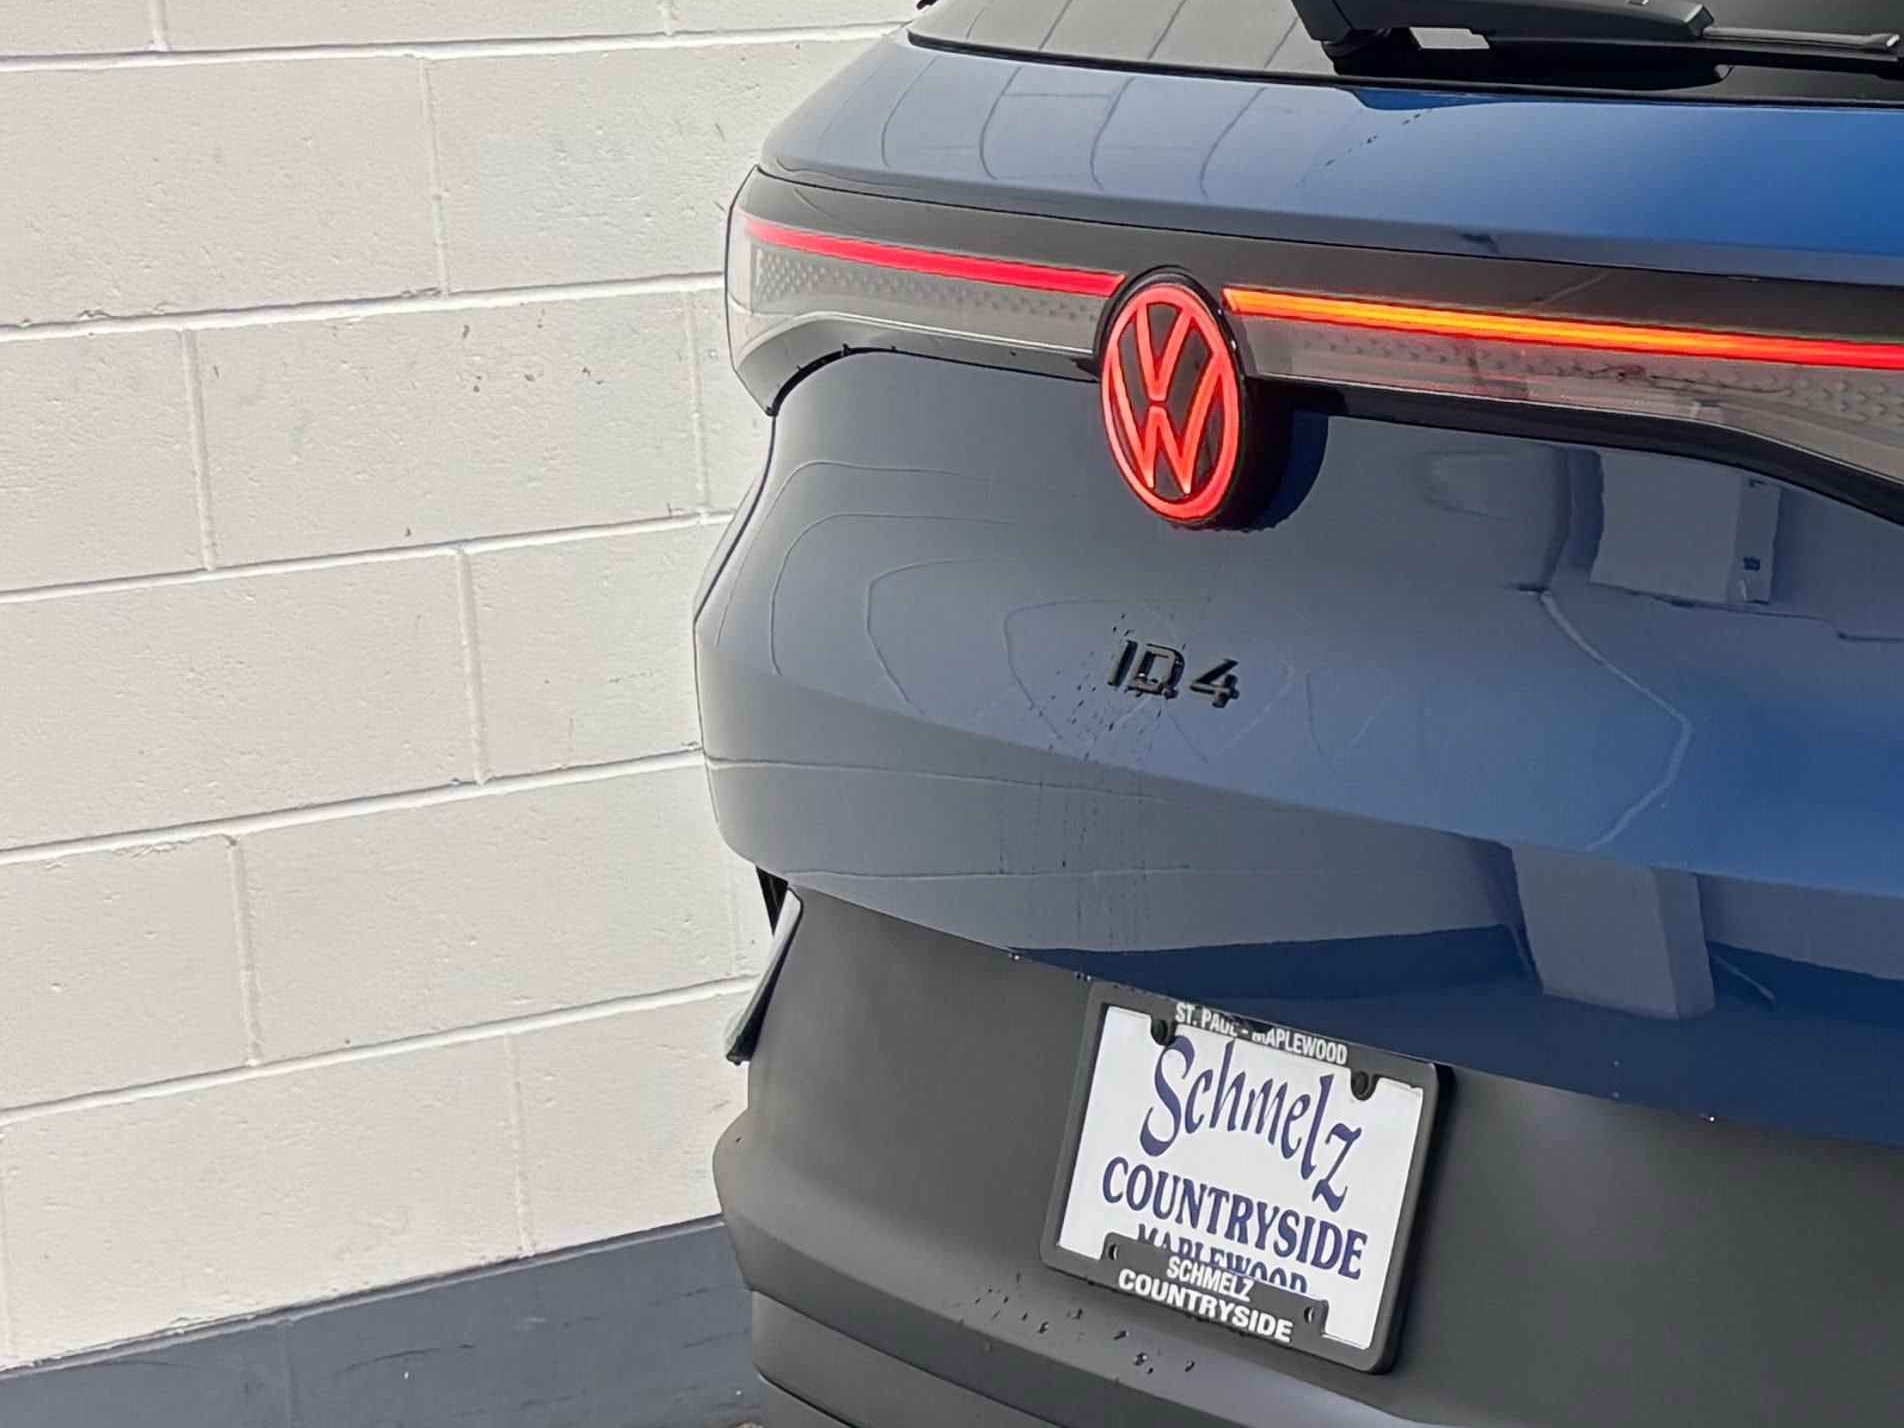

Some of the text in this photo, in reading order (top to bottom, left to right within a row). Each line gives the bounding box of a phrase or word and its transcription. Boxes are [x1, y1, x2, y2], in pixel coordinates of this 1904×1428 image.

[1175, 1002, 1197, 1026] ST.
[1140, 1035, 1362, 1212] Schmelz
[1102, 1157, 1368, 1280] COUNTRYSIDE
[1118, 1268, 1294, 1343] COUNTRYSIDE
[1166, 1255, 1254, 1302] SCHMELZ
